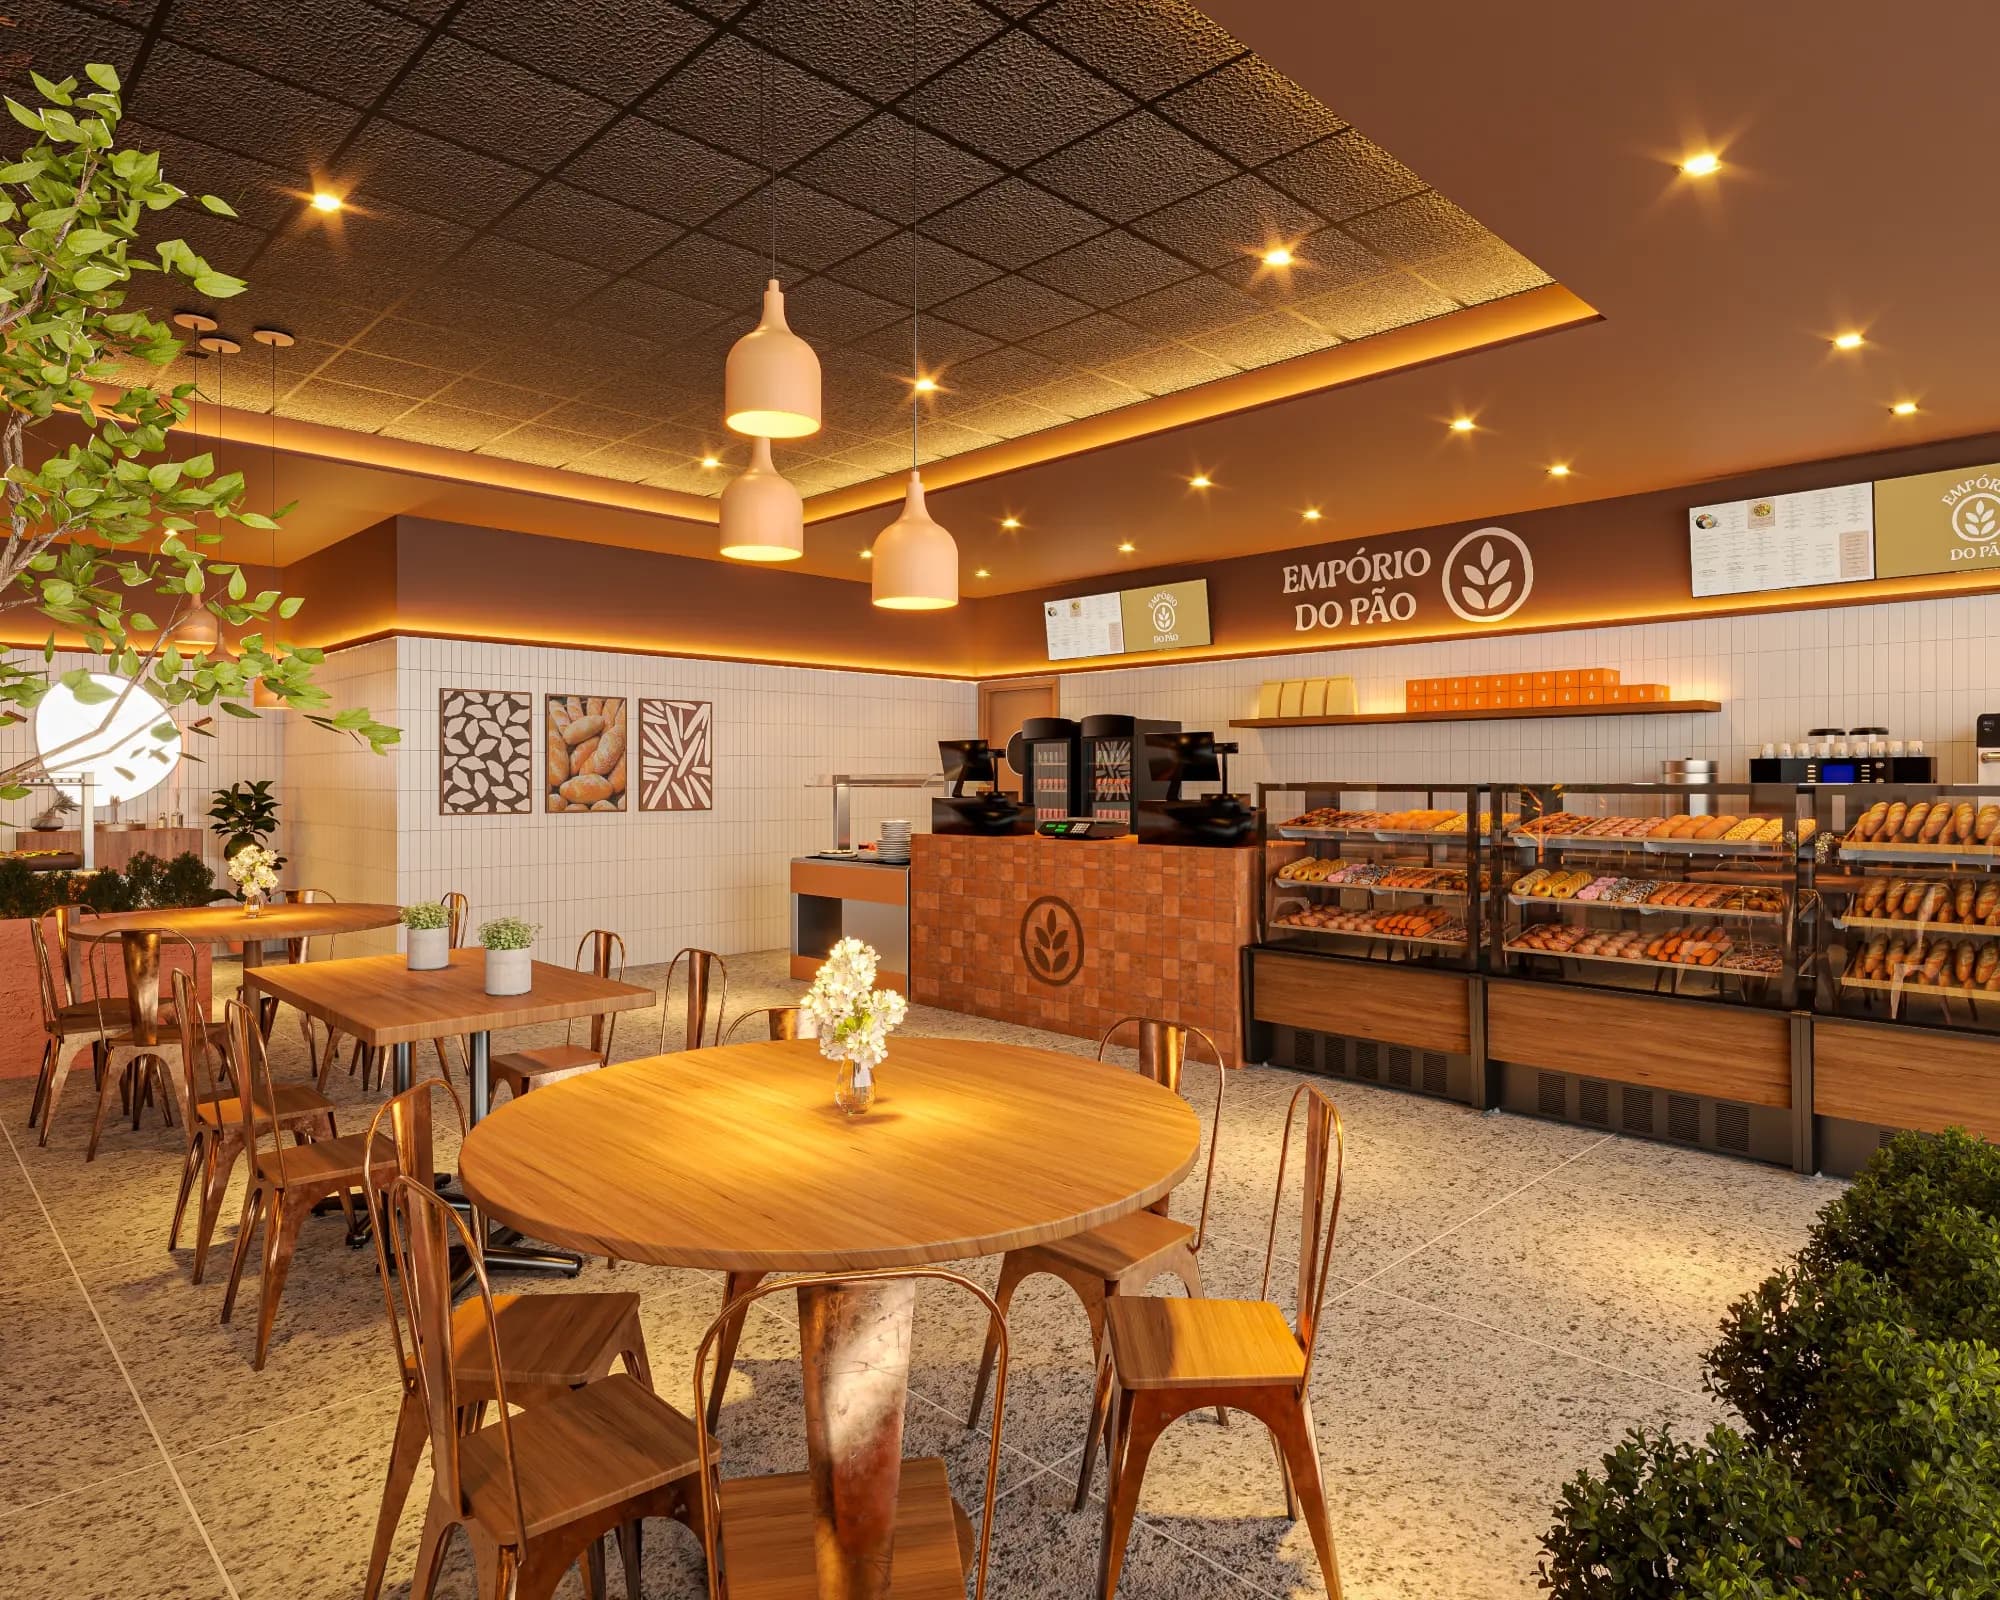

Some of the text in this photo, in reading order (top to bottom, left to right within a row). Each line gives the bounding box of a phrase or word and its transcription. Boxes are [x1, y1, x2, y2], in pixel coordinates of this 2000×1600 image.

[1950, 547, 1976, 561] DO
[1282, 546, 1432, 594] EMPÓRIO
[1147, 590, 1178, 610] EMPÓRIO
[1295, 586, 1417, 631] DO PÃO
[1153, 632, 1179, 644] DO PÃO
